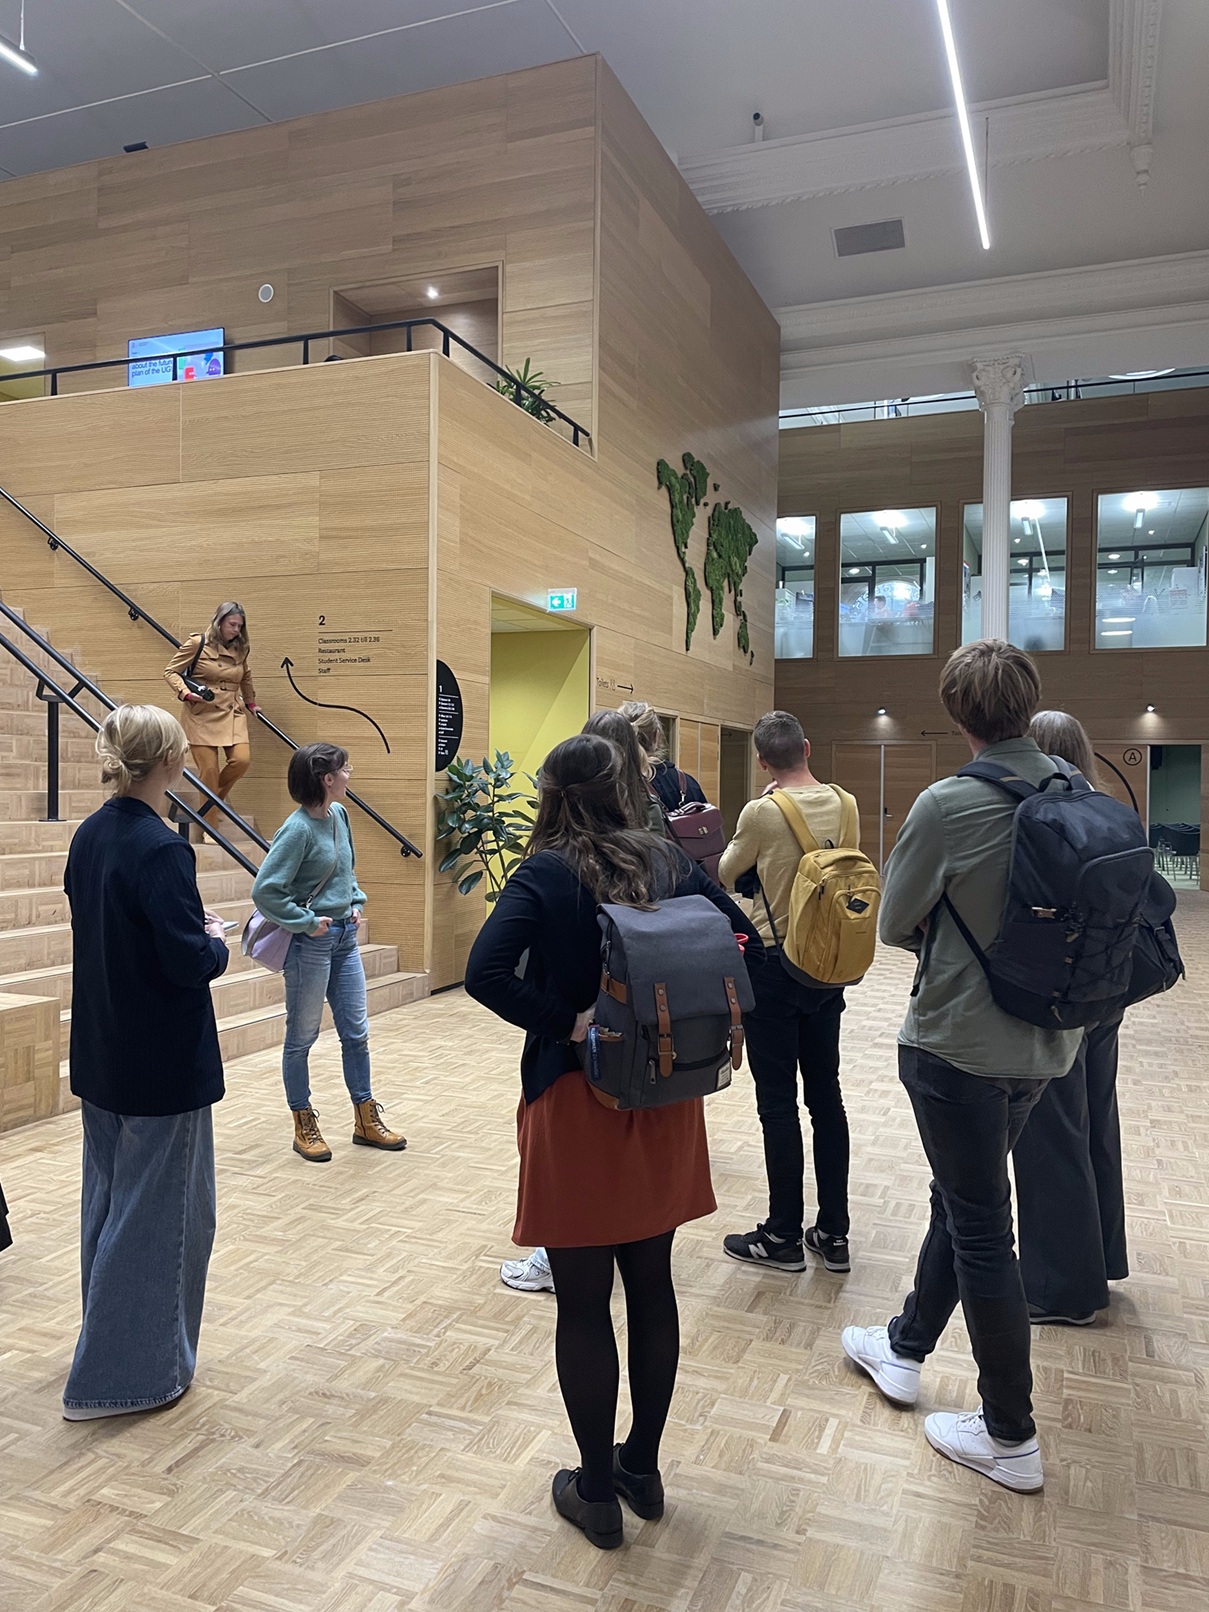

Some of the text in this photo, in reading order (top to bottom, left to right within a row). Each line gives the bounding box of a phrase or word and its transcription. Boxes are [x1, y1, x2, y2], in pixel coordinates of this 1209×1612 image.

[132, 359, 172, 370] about the futur
[131, 370, 143, 378] plan
[151, 367, 160, 375] the
[319, 615, 326, 626] 2
[1128, 751, 1137, 762] A
